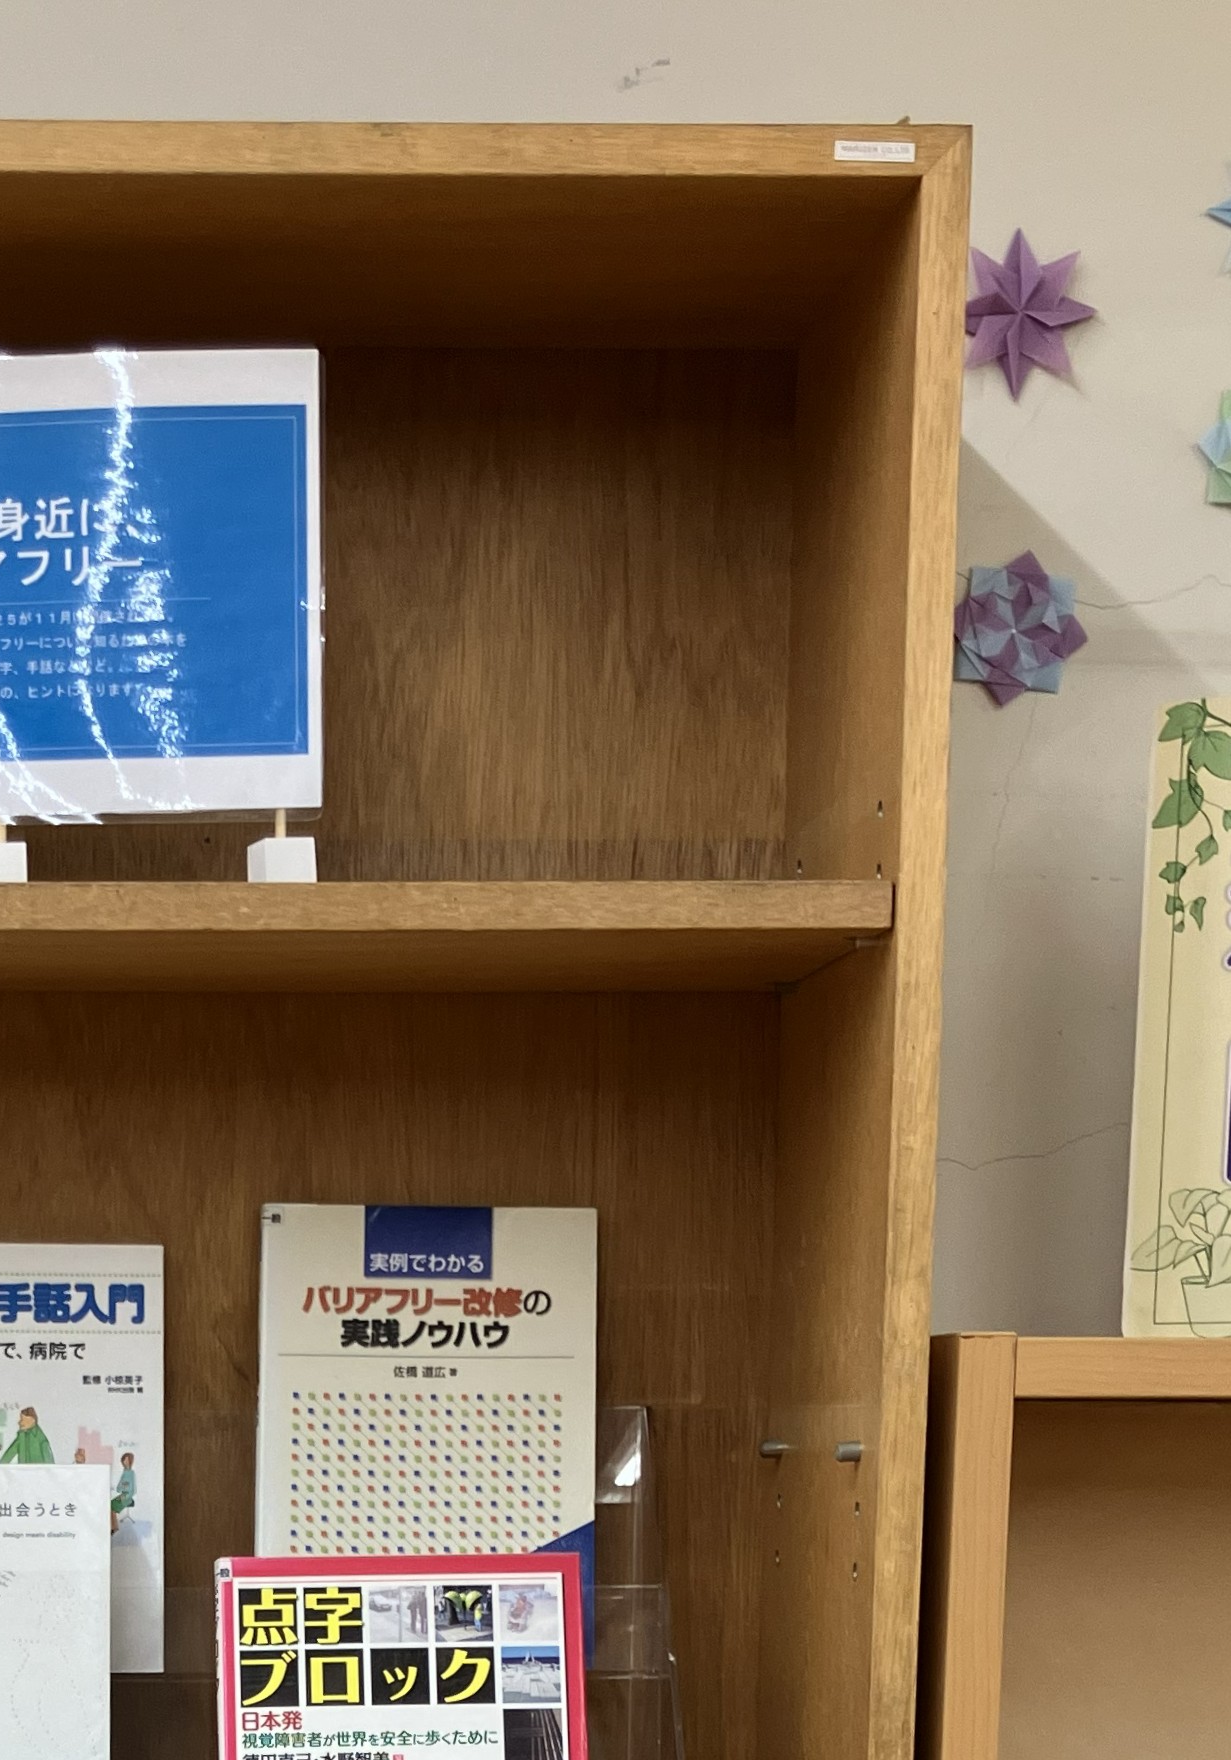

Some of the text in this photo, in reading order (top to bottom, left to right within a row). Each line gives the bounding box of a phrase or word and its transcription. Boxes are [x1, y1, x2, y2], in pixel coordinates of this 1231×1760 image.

[370, 1254, 484, 1273] 実例でわかる
[303, 1287, 552, 1317] バリアフリー改修の
[341, 1320, 510, 1348] 実践ノウハウ
[240, 1586, 364, 1646] 点字
[241, 1649, 492, 1706] ブロック
[242, 1711, 303, 1731] 日本発
[242, 1729, 499, 1748] 視覚障害者が世界を安全に歩くために
